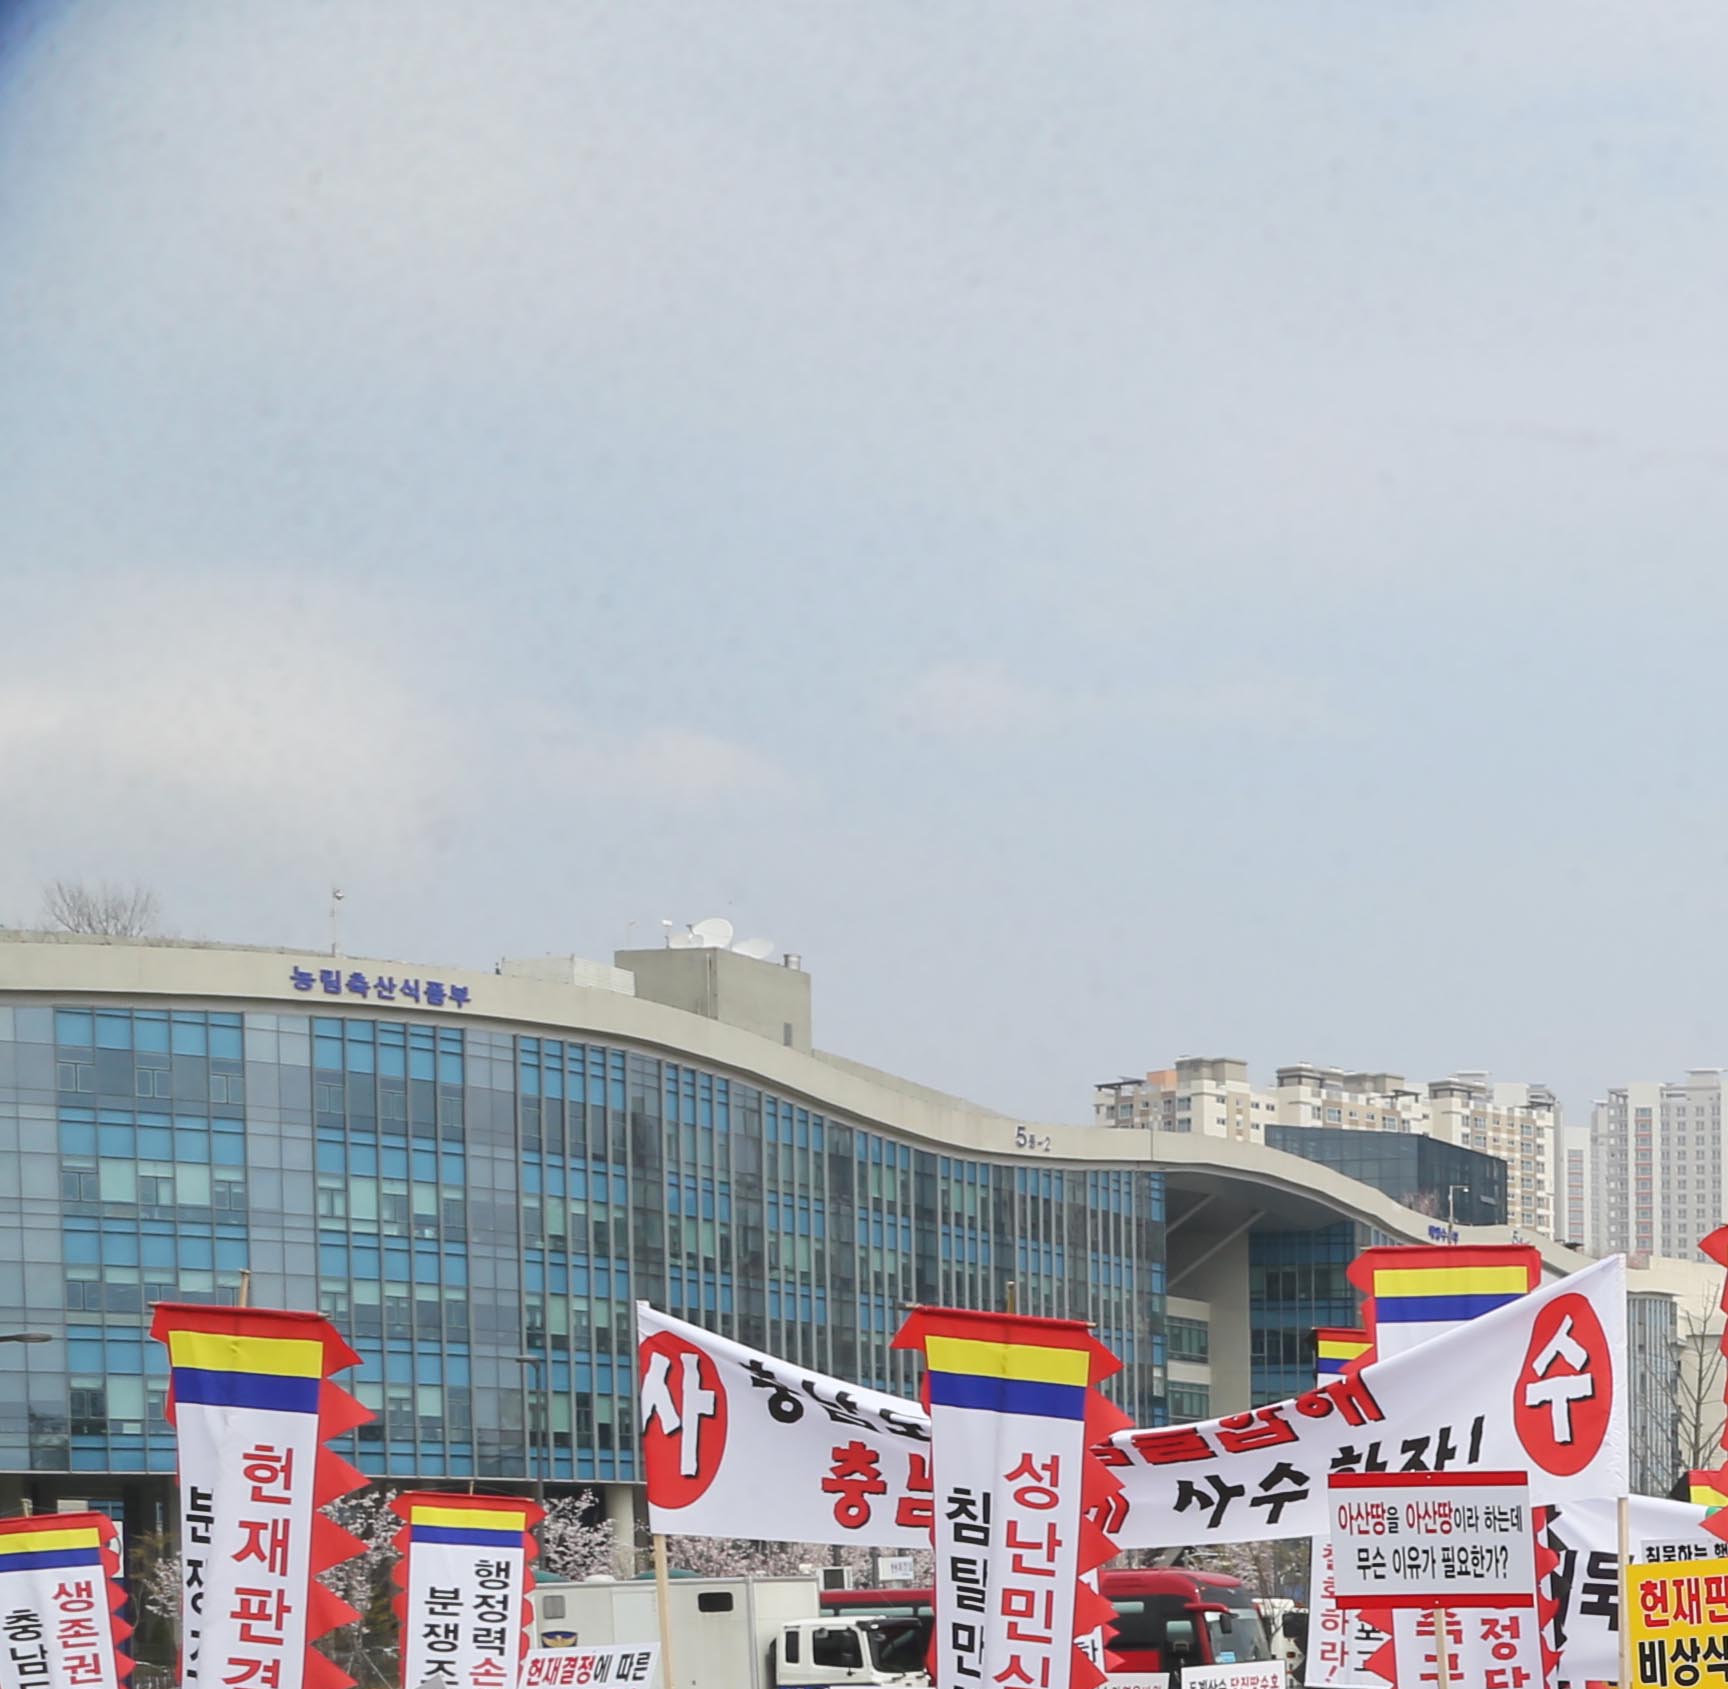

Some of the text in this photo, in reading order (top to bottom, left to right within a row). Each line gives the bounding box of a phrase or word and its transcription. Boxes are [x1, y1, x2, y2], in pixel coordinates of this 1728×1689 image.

[290, 964, 470, 1009] 농림축산식품부
[1524, 1315, 1594, 1445] 수
[642, 1351, 716, 1479] 사
[1337, 1501, 1524, 1537] 아산땅을 아산땅이라 하는데
[1356, 1544, 1509, 1581] 무슨 이유가 필요한가?
[526, 1651, 651, 1688] 헌재결정에 따른
